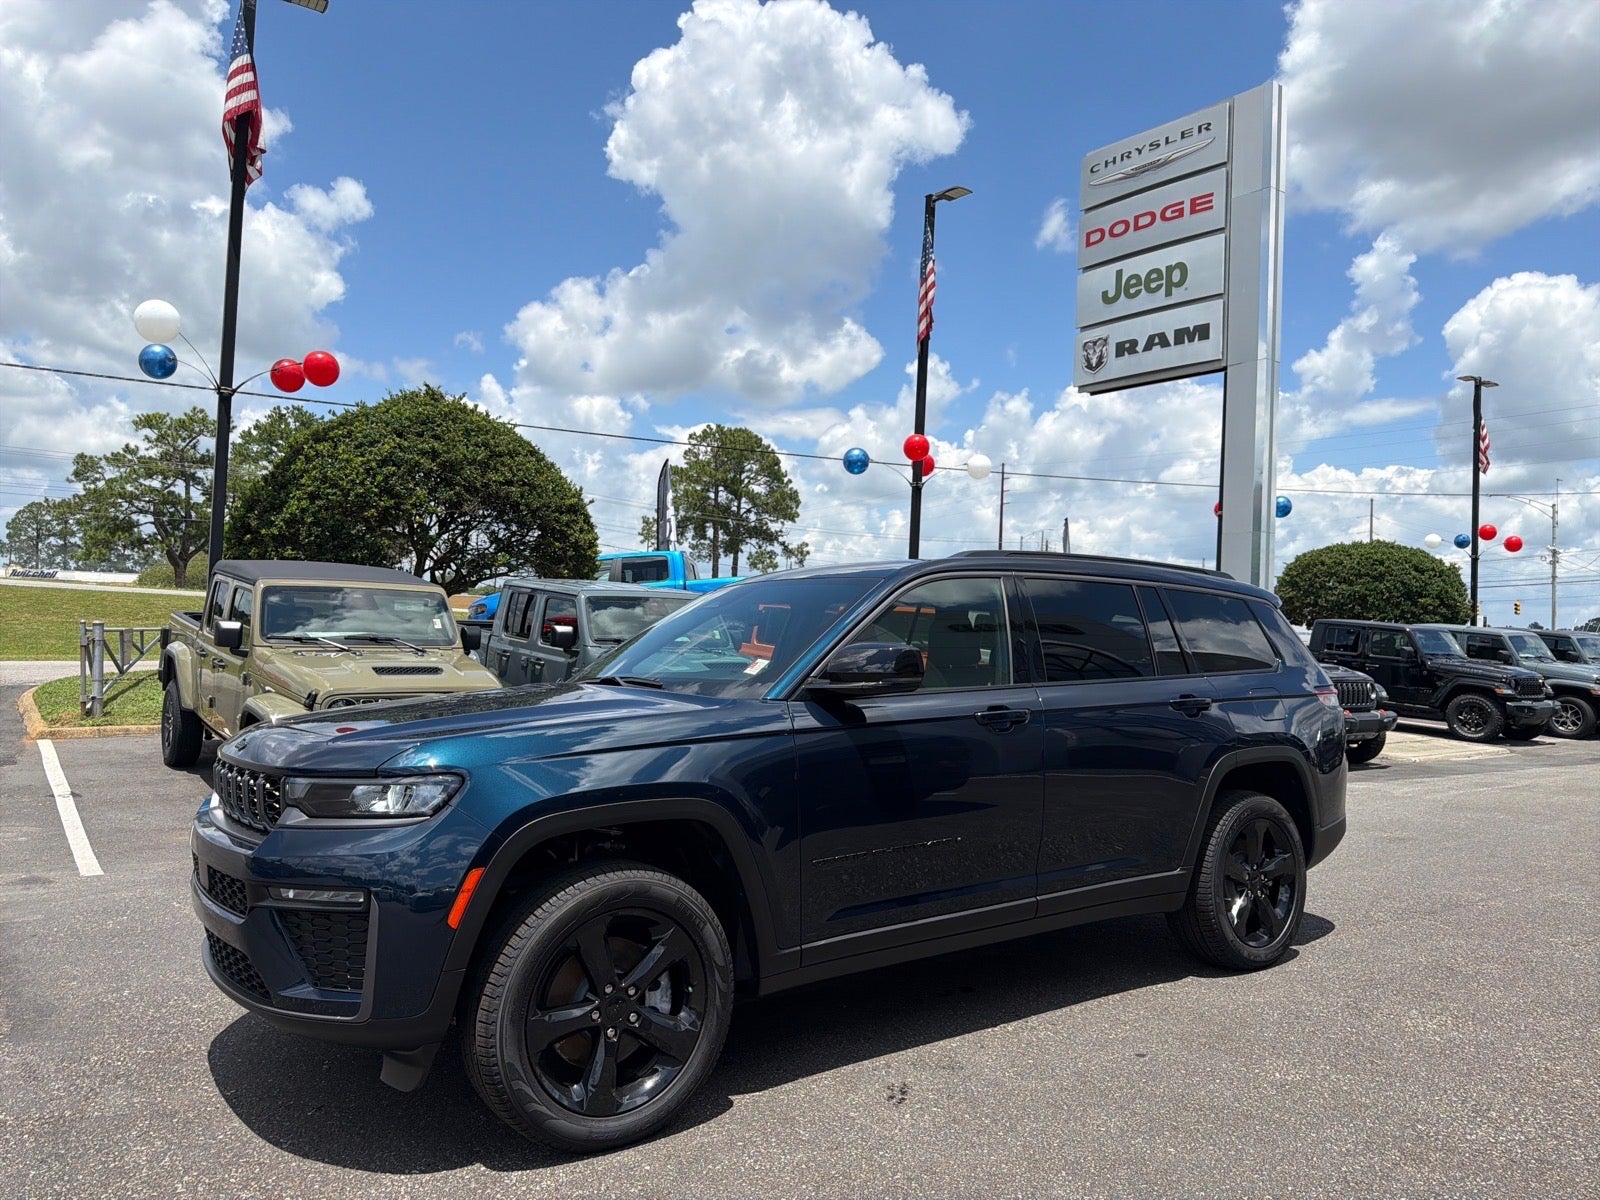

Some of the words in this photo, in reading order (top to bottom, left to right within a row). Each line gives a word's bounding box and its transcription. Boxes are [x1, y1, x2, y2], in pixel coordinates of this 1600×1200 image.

[1089, 121, 1213, 174] CHRYSLER
[1085, 192, 1214, 248] DODGE
[1101, 261, 1189, 305] Jeep
[1115, 322, 1211, 358] RAM
